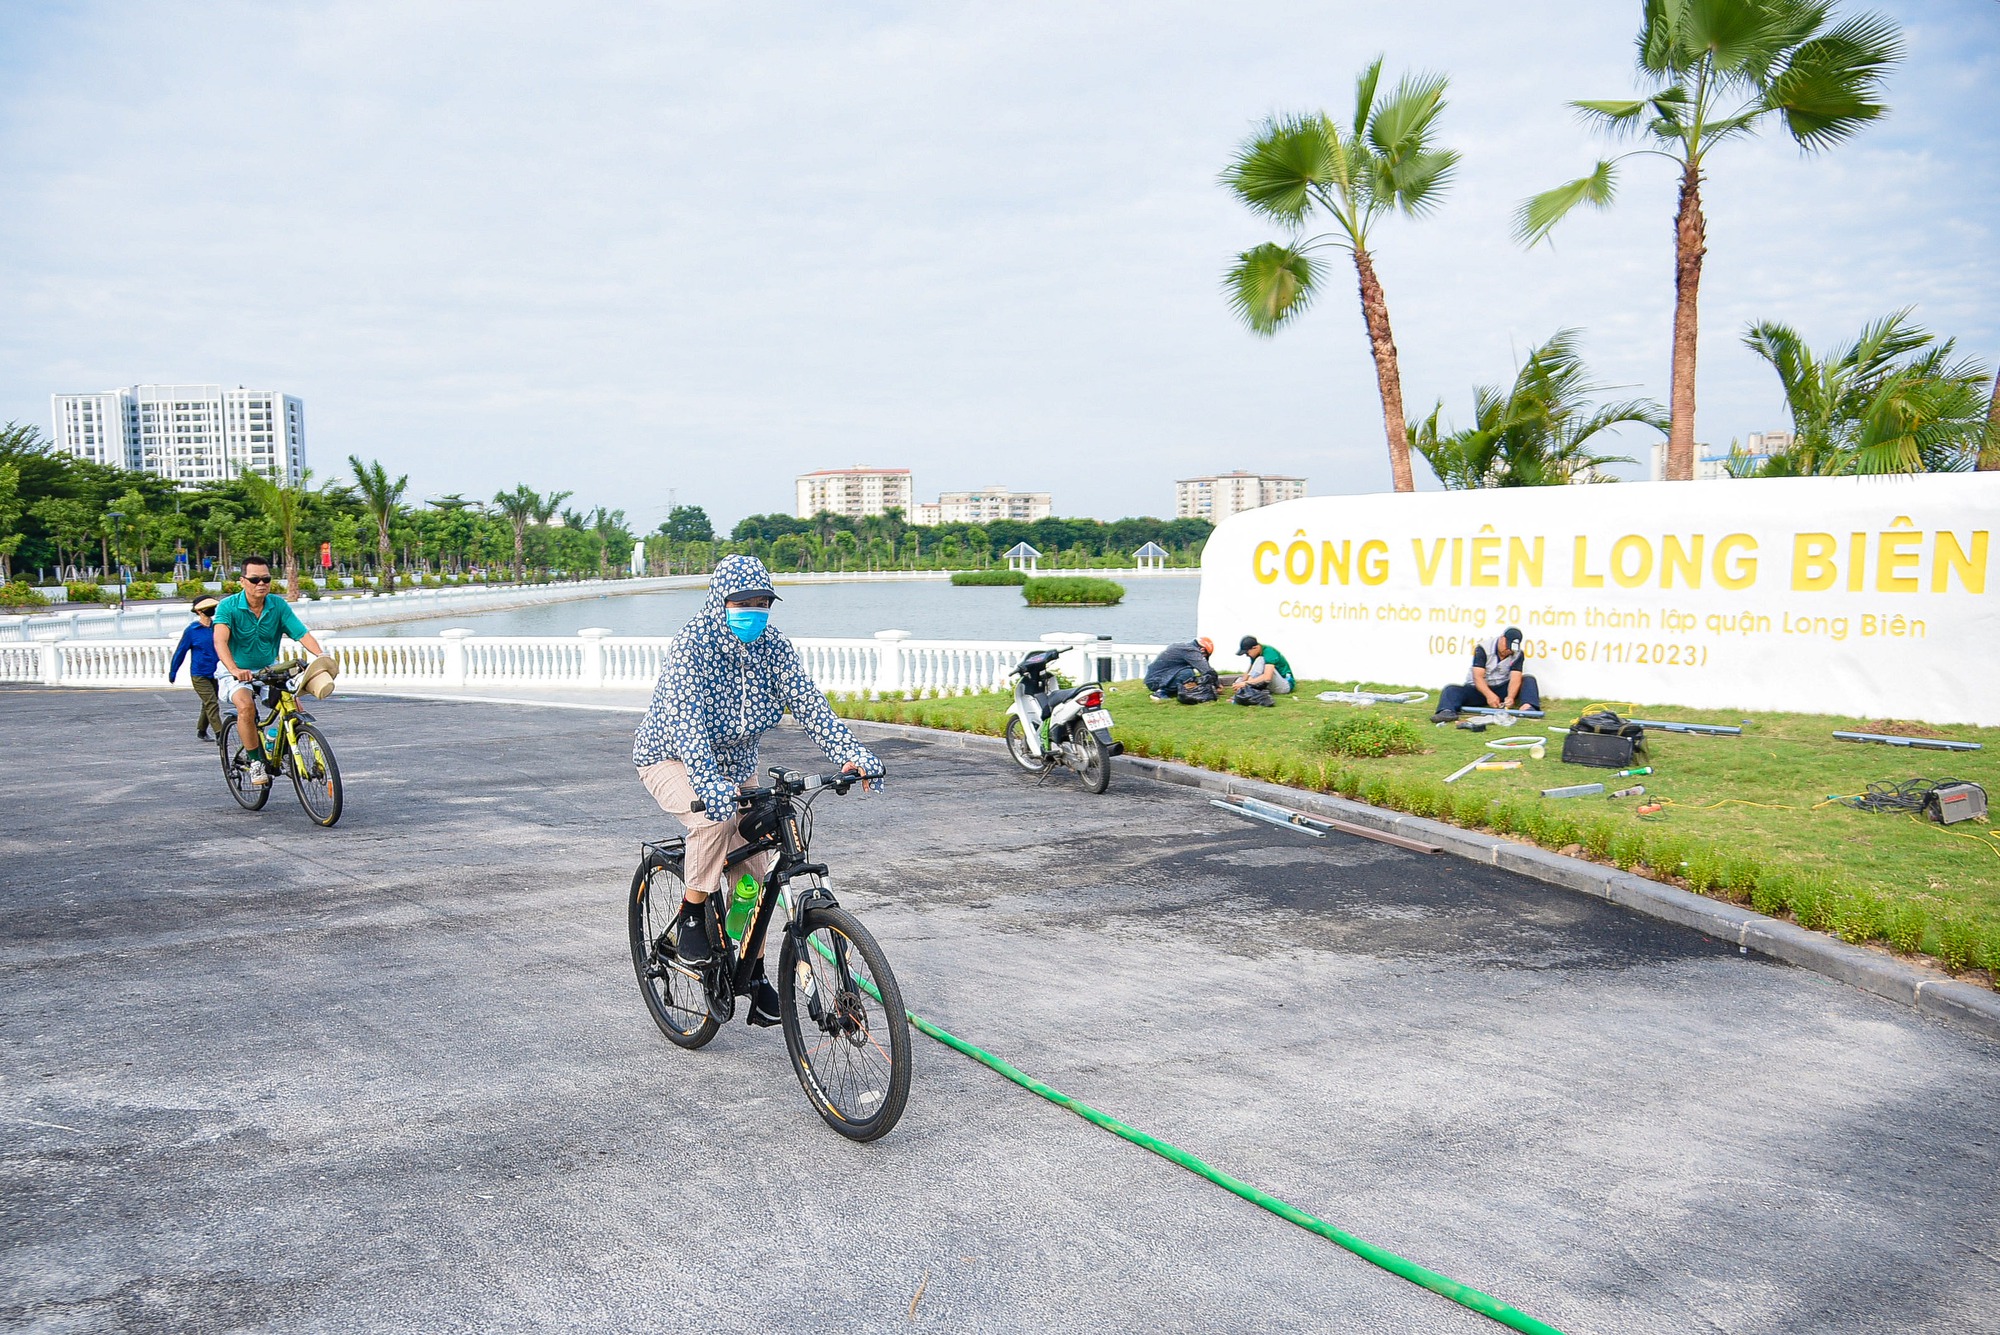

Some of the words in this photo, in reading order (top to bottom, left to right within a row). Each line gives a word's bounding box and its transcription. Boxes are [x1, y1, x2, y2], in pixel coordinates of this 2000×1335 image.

[1253, 529, 1390, 586] CÔNG
[1411, 524, 1545, 588] VIÊN
[1572, 532, 1759, 591] LONG
[1791, 515, 1990, 594] BIÊN
[1279, 601, 1323, 623] Công
[1330, 602, 1369, 620] trình
[1376, 603, 1422, 622] chào
[1429, 604, 1486, 628] mừng
[1496, 605, 1521, 624] 20
[1529, 605, 1576, 626] năm
[1585, 607, 1650, 628] thành
[1661, 609, 1697, 633] lập
[1706, 611, 1771, 636] quận
[1783, 612, 1849, 641] Long
[1861, 613, 1926, 638] Biên
